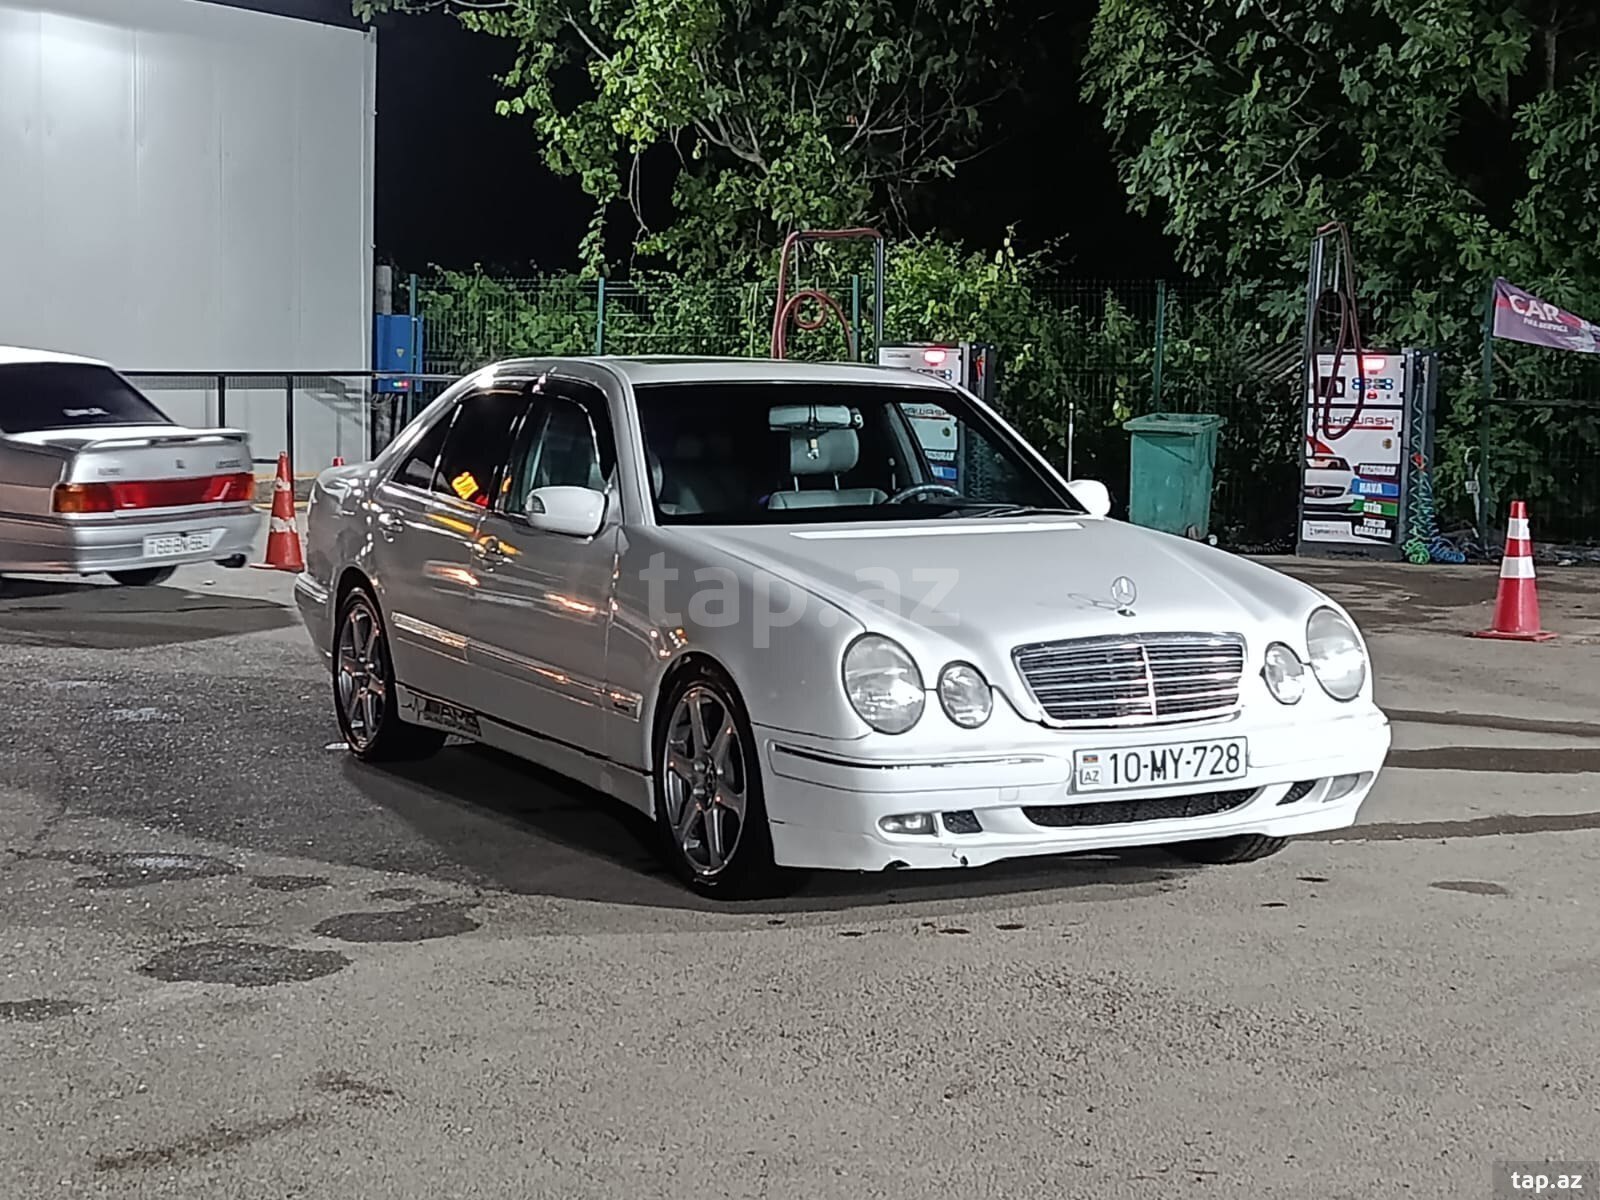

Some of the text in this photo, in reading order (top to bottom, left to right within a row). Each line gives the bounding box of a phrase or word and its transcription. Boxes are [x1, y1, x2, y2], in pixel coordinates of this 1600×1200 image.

[1509, 295, 1562, 323] CAR
[1084, 770, 1100, 783] AZ
[1109, 743, 1240, 784] 10-MY-728
